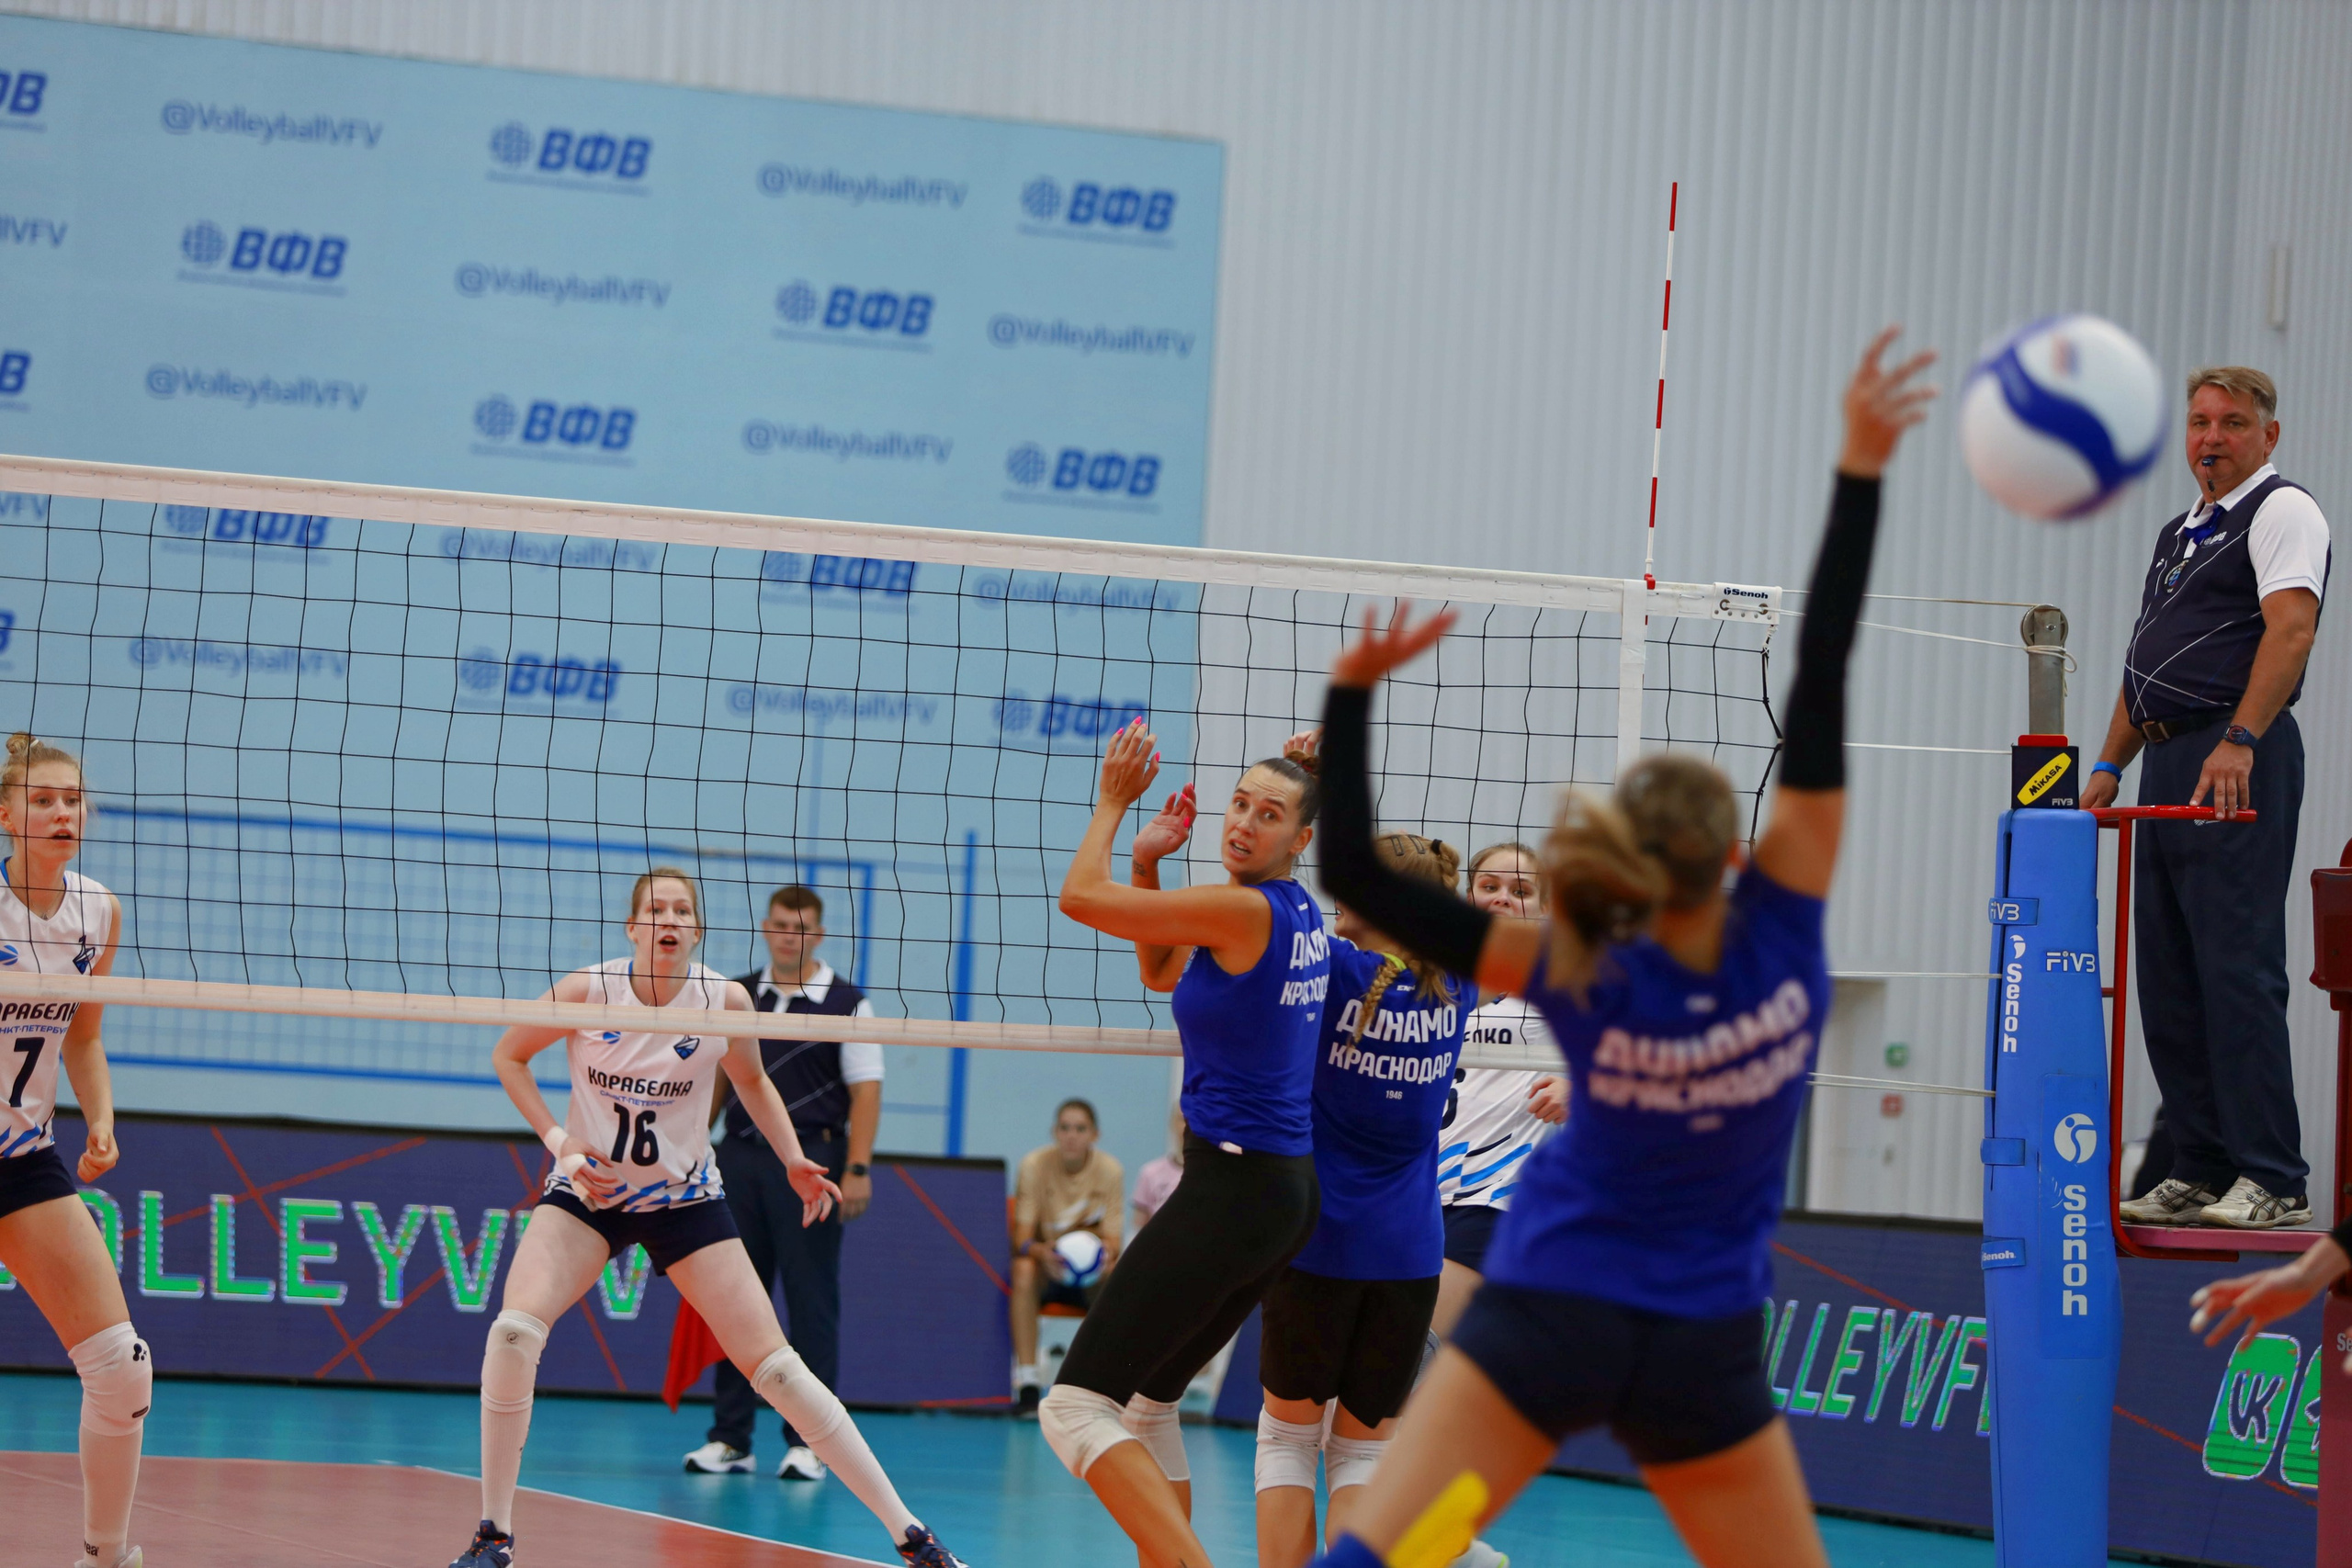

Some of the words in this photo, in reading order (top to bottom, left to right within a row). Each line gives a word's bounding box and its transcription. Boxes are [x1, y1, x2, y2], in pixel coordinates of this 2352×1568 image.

[161, 99, 383, 149] @VolleyballVFV
[537, 129, 653, 180] ВФВ
[757, 163, 967, 209] @VolleyballVFV
[1066, 182, 1177, 233] ВФВ
[230, 226, 348, 280] ВФВ
[455, 261, 671, 310] @VolleyballVFV
[822, 286, 934, 337] ВФВ
[987, 313, 1194, 359] @VolleyballVFV
[144, 363, 367, 411] @VolleyballVFV
[521, 400, 636, 451] ВФВ
[741, 419, 954, 465] @VolleyballVFV
[1051, 447, 1161, 498] ВФВ
[439, 529, 658, 573] @VolleyballVFV
[973, 573, 1182, 616] @VolleyballVFV
[1732, 588, 1769, 600] Senoh
[129, 633, 347, 678] @VolleyballVFV
[506, 653, 621, 702] ВФВ
[726, 682, 938, 727] @VolleyballVFV
[2002, 963, 2023, 1054] Senoh
[8, 1036, 46, 1108] 7
[588, 1066, 694, 1098] КОРАБЕЛКА
[1328, 1042, 1453, 1085] КРАСНОДАР
[1385, 1089, 1403, 1100] 1946
[610, 1102, 660, 1167] 16
[2063, 1184, 2088, 1316] Senoh
